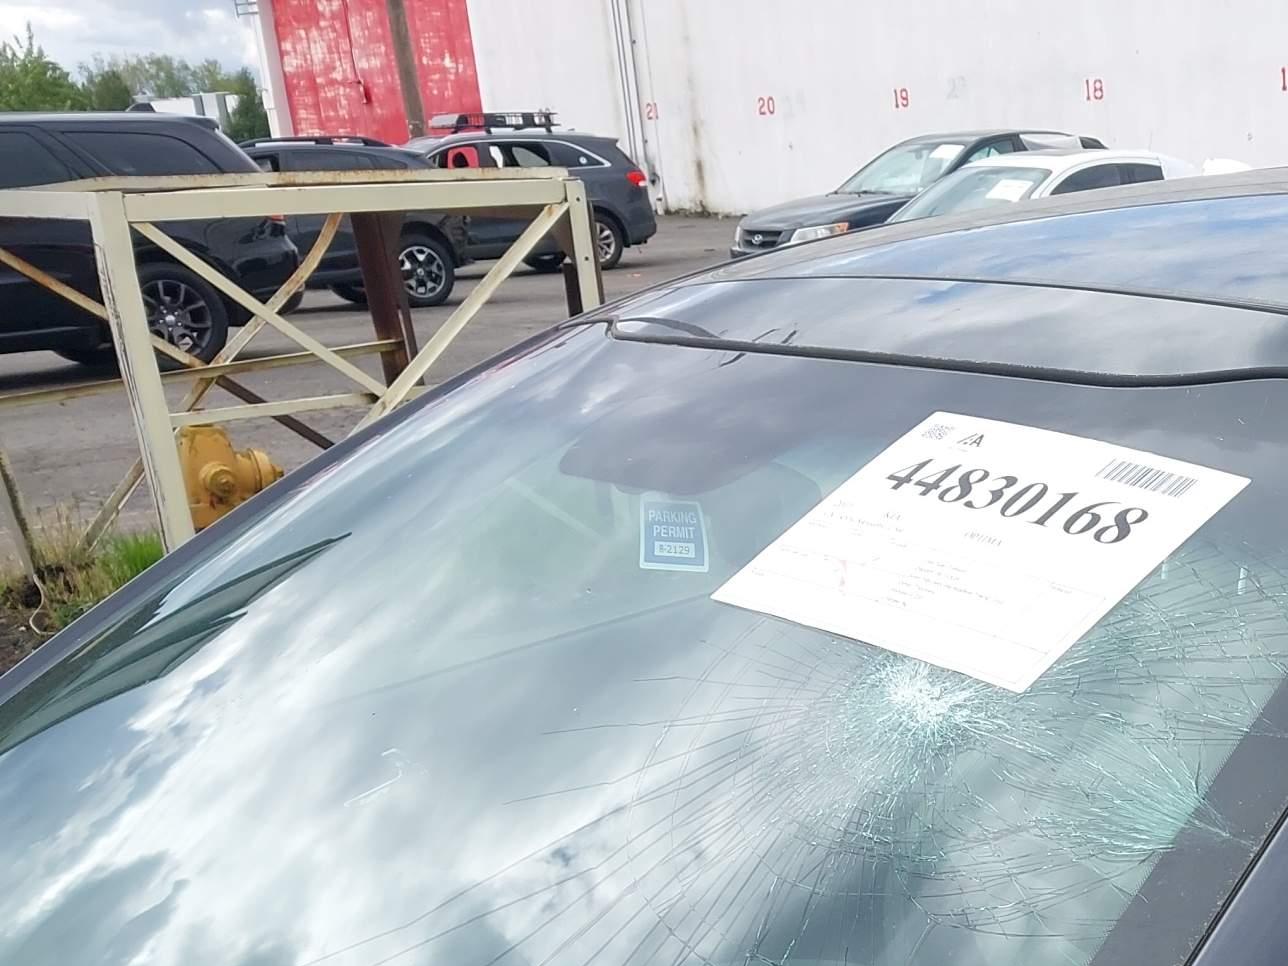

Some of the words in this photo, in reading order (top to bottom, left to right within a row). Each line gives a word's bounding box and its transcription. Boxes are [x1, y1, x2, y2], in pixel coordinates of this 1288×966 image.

[894, 88, 909, 108] 19
[1085, 79, 1104, 101] 18
[646, 103, 659, 120] 21
[758, 96, 775, 115] 20
[885, 458, 1149, 544] 44830168
[648, 509, 697, 523] PARKING
[653, 525, 696, 539] PERMIT
